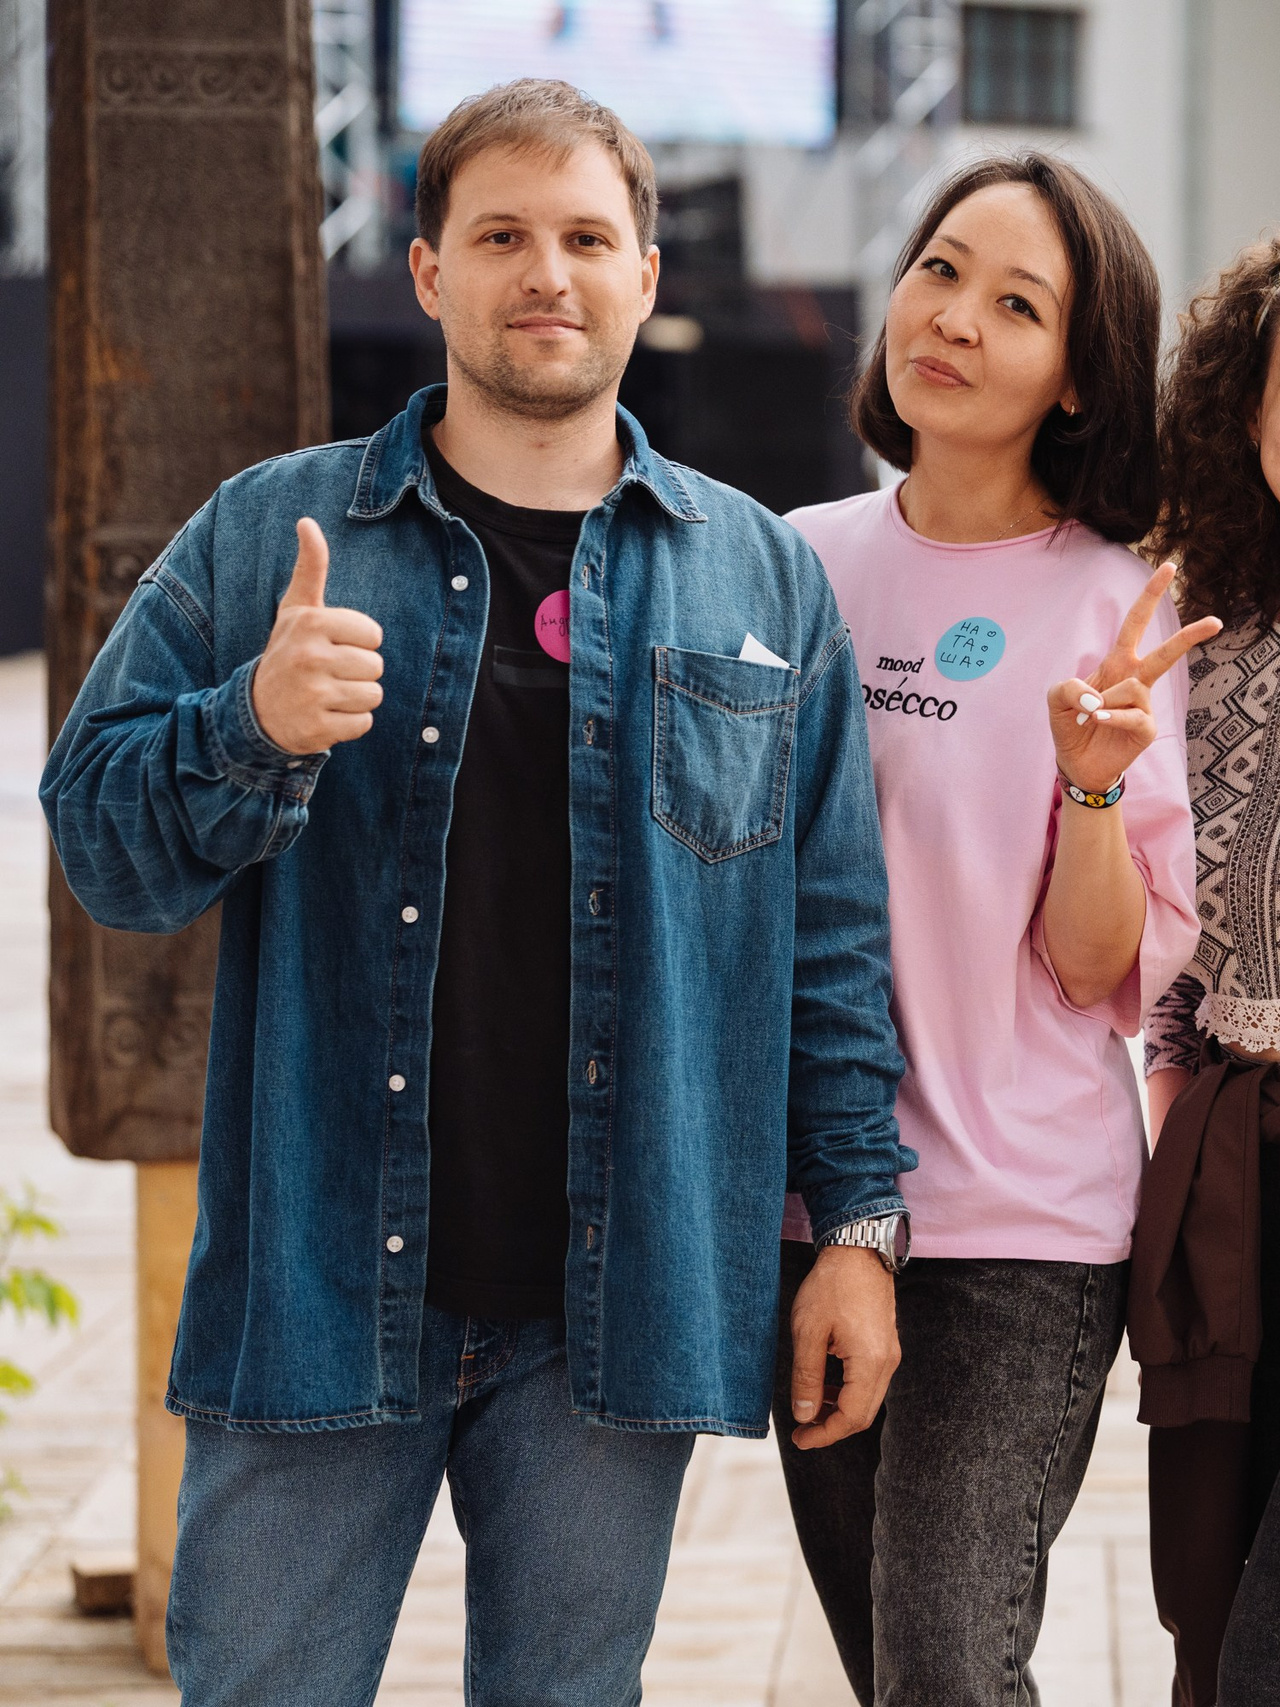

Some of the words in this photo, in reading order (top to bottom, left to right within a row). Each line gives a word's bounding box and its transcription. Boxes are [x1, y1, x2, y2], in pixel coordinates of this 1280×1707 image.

[960, 621, 979, 635] НА
[954, 634, 975, 652] ТА
[876, 656, 925, 674] mood
[940, 651, 972, 668] ША
